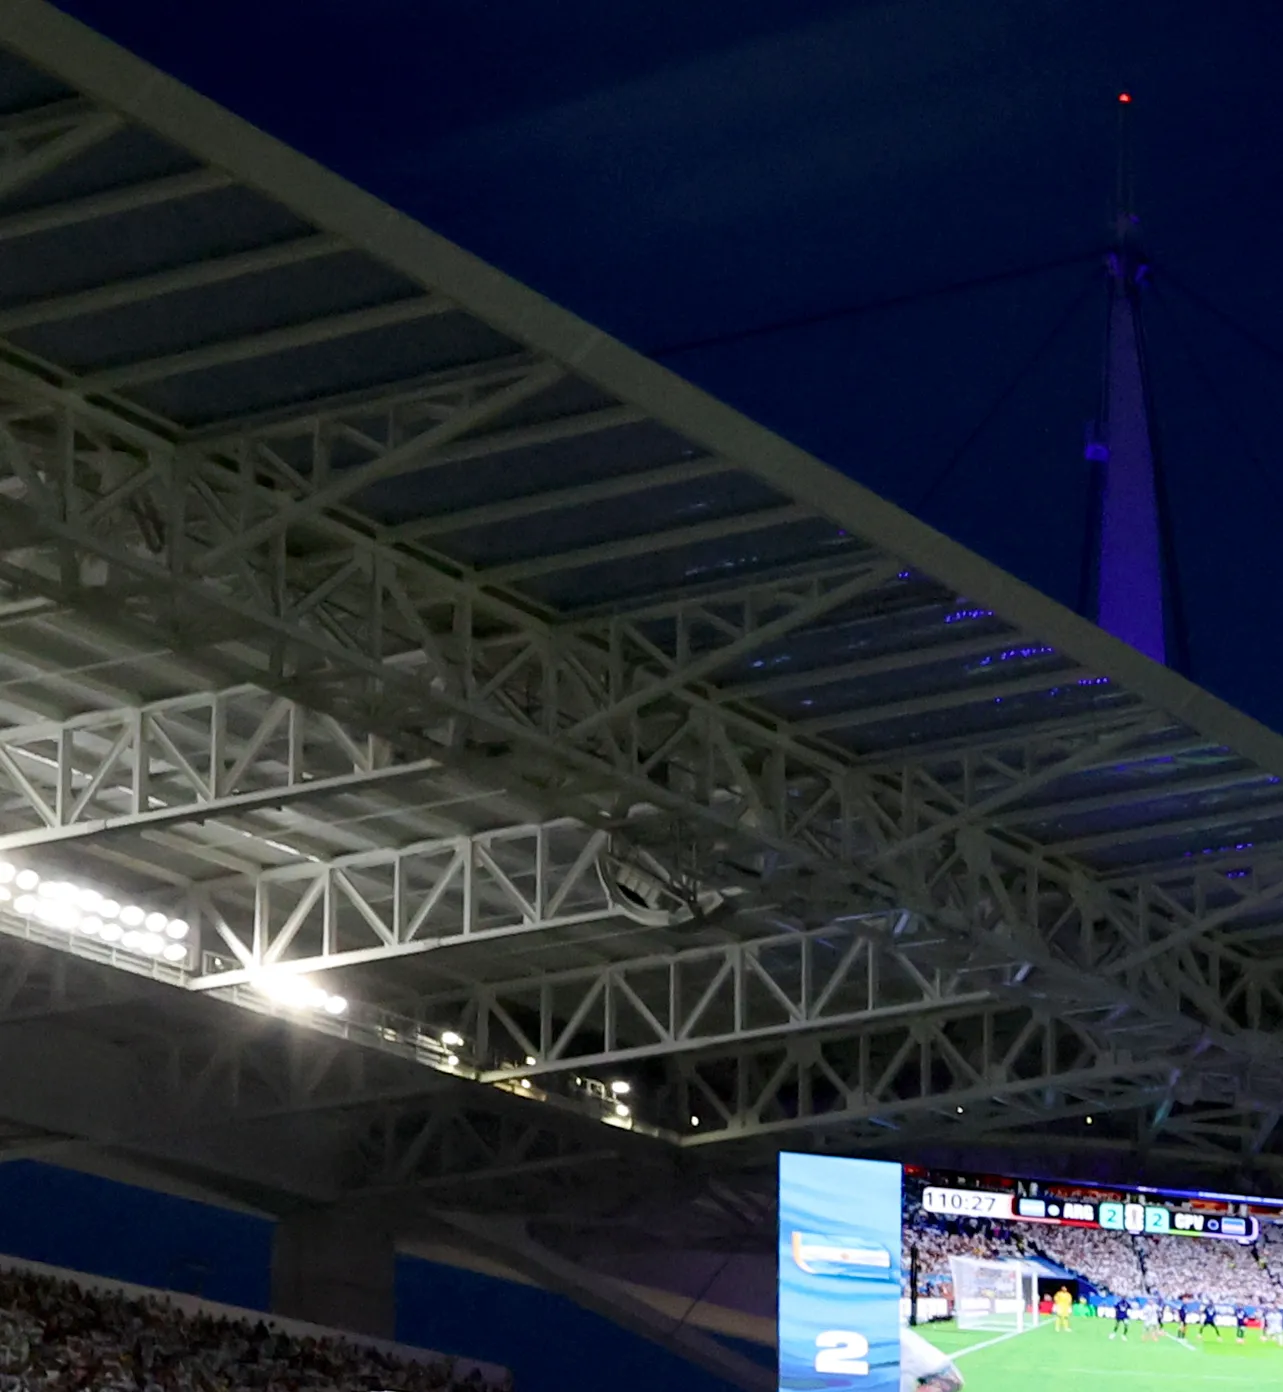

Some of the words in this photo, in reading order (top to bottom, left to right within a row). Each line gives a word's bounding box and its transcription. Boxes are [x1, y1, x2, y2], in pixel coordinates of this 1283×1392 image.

[926, 1190, 996, 1213] 110:27
[1063, 1203, 1095, 1221] ARG
[1106, 1208, 1118, 1226] 2
[1152, 1212, 1164, 1228] 2
[814, 1330, 870, 1376] 2
